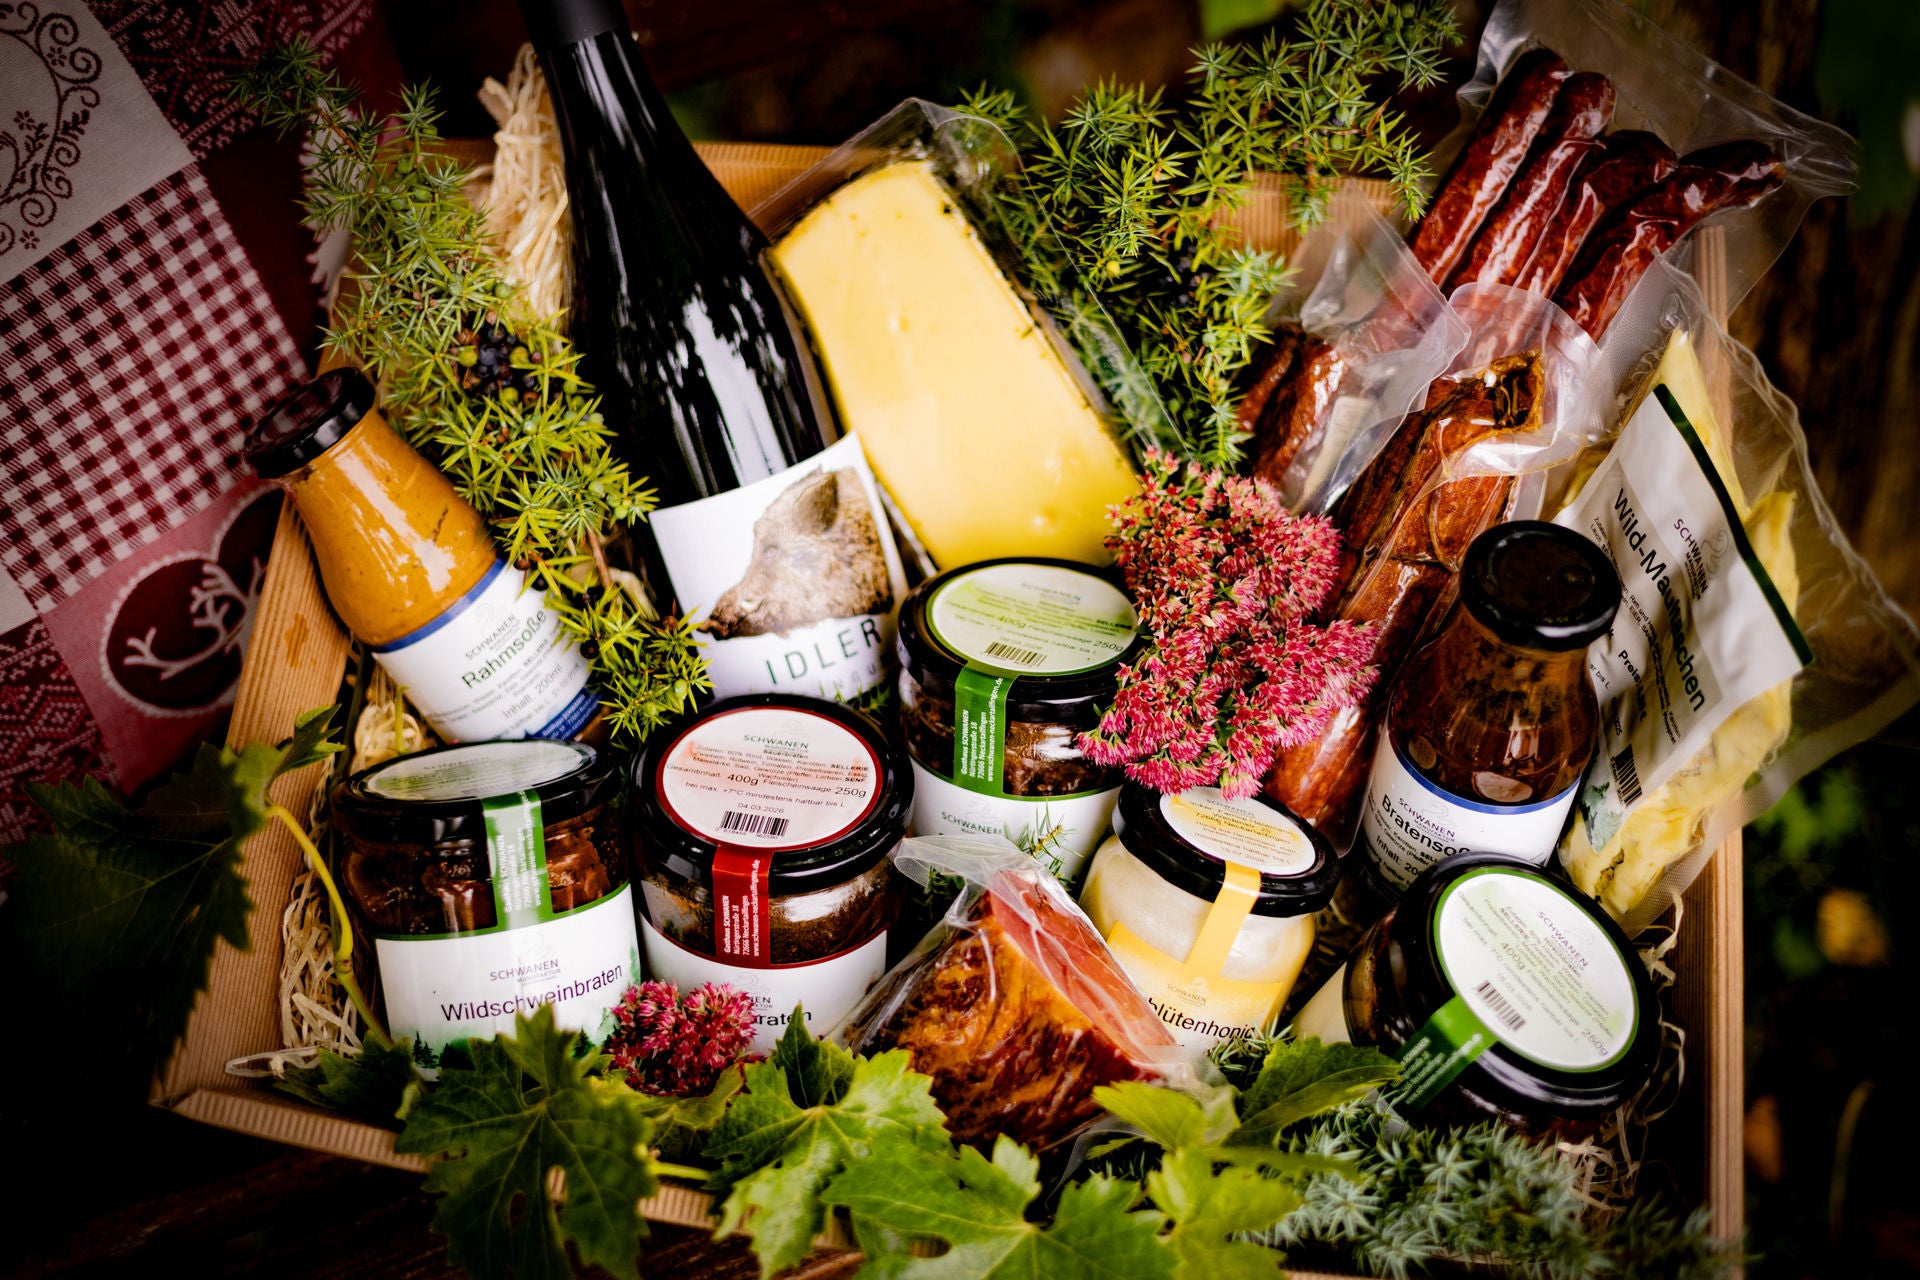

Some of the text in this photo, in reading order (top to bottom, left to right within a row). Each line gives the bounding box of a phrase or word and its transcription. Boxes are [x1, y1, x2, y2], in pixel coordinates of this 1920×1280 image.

[1674, 518, 1708, 592] SCHWANEN
[1613, 487, 1705, 712] Wild-Maultaschen
[460, 608, 547, 688] Rahmsoße
[464, 613, 516, 660] SCHWANEN
[764, 617, 882, 685] IDLER
[998, 615, 1026, 629] 400g
[1092, 639, 1123, 652] 250g
[1618, 650, 1641, 686] Preis:
[743, 734, 808, 749] SCHWANEN
[960, 709, 970, 745] SCHWANEN
[763, 748, 808, 760] Sauerbraten
[685, 780, 699, 790] bei
[745, 790, 792, 803] mindestens
[795, 795, 822, 807] haltbar
[824, 799, 838, 807] bis
[727, 773, 758, 786] 400g
[762, 778, 831, 792] Fleischeinwaage
[835, 785, 866, 799] 250g
[942, 811, 1001, 833] SCHWANEN
[1399, 797, 1455, 837] SCHWANEN
[1375, 835, 1402, 864] Inhalt:
[721, 895, 731, 952] Gasthaus SCHWANEN
[1536, 909, 1589, 968] SCHWANEN
[489, 957, 559, 980] SCHWANEN
[1543, 936, 1582, 978] Hirschbraten
[440, 964, 622, 1020] Wildschweinbraten
[1499, 940, 1527, 971] 400g
[1580, 1026, 1610, 1058] 250g
